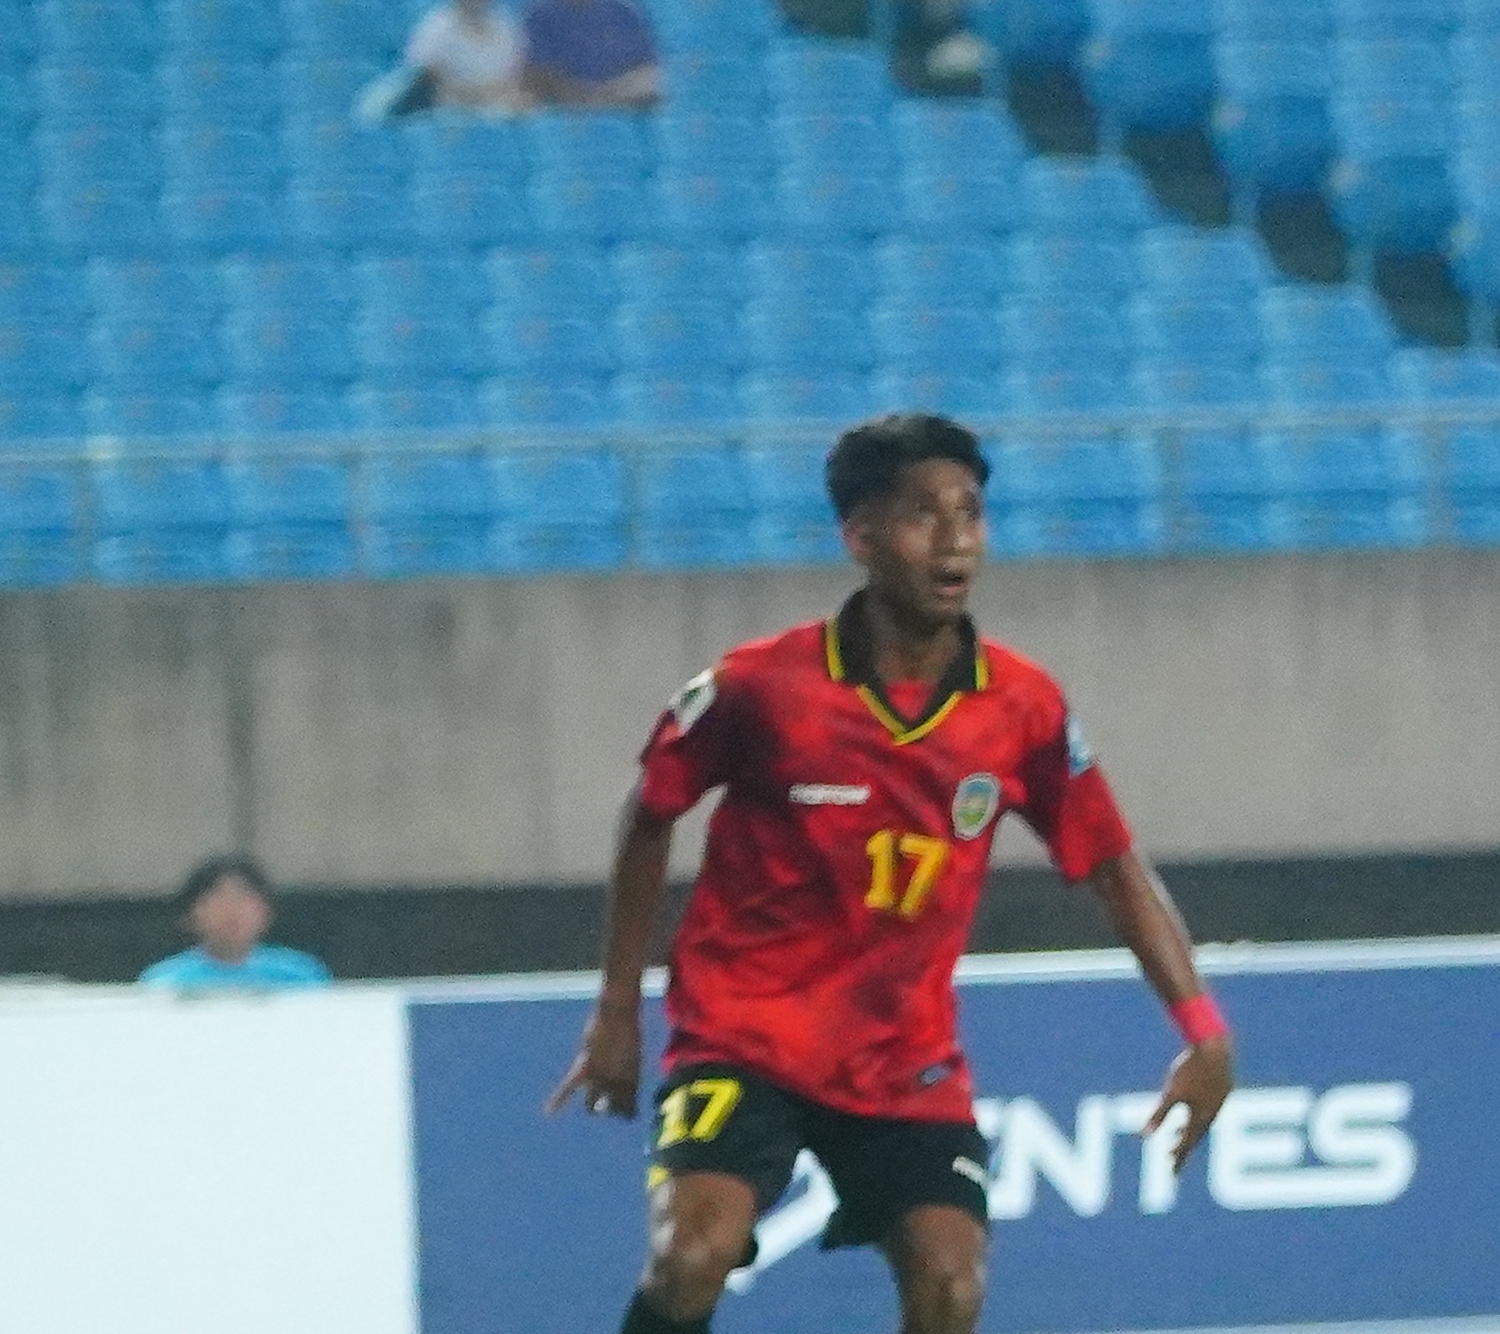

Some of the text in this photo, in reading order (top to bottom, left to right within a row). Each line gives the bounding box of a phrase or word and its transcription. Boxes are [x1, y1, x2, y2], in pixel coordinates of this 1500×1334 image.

[864, 829, 951, 919] 17
[657, 1077, 742, 1150] 17
[970, 1081, 1418, 1221] NTES
